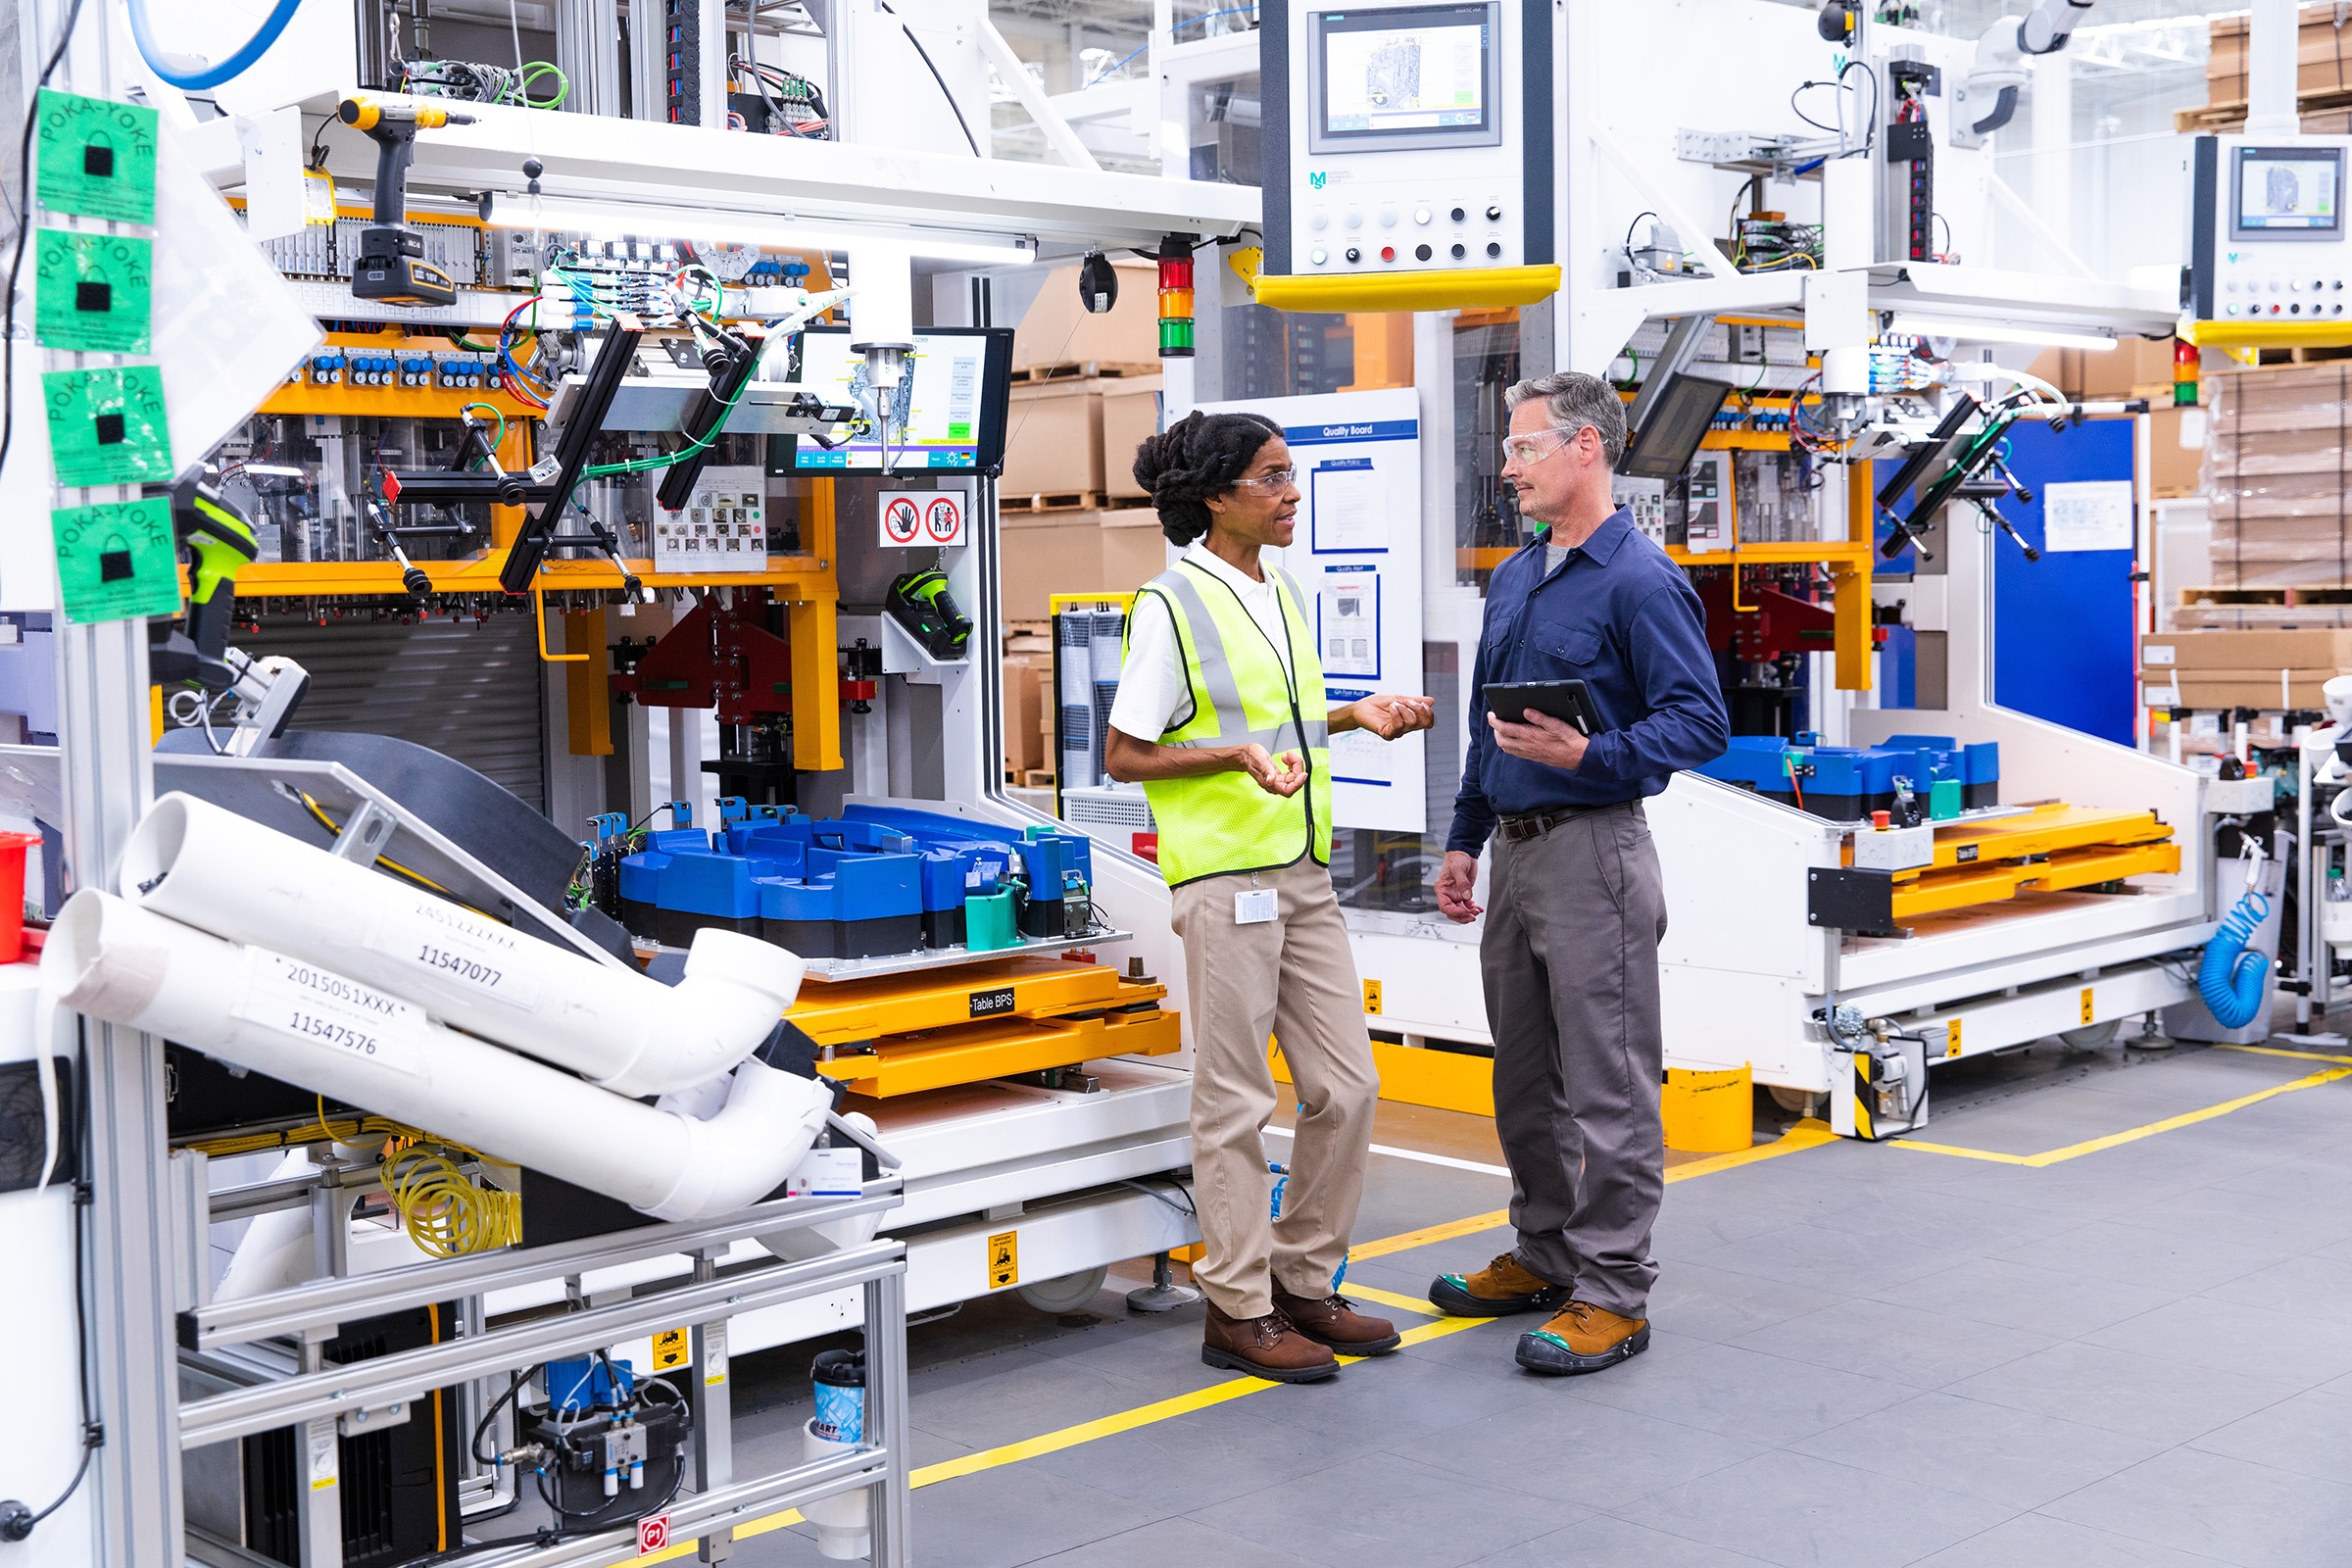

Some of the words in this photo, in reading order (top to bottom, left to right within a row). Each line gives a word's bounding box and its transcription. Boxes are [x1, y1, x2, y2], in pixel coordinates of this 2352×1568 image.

[40, 99, 153, 157] POKA-YOKE
[37, 235, 148, 287] POKA-YOKE
[48, 368, 162, 421] POKA-YOKE
[1323, 426, 1348, 437] Quality
[1350, 424, 1372, 435] Board
[59, 503, 169, 559] POKA-YOKE
[418, 945, 502, 987] 11547077
[972, 997, 994, 1010] Table
[995, 993, 1013, 1007] BPS
[290, 1011, 377, 1054] 11547576
[647, 1528, 661, 1543] P1
